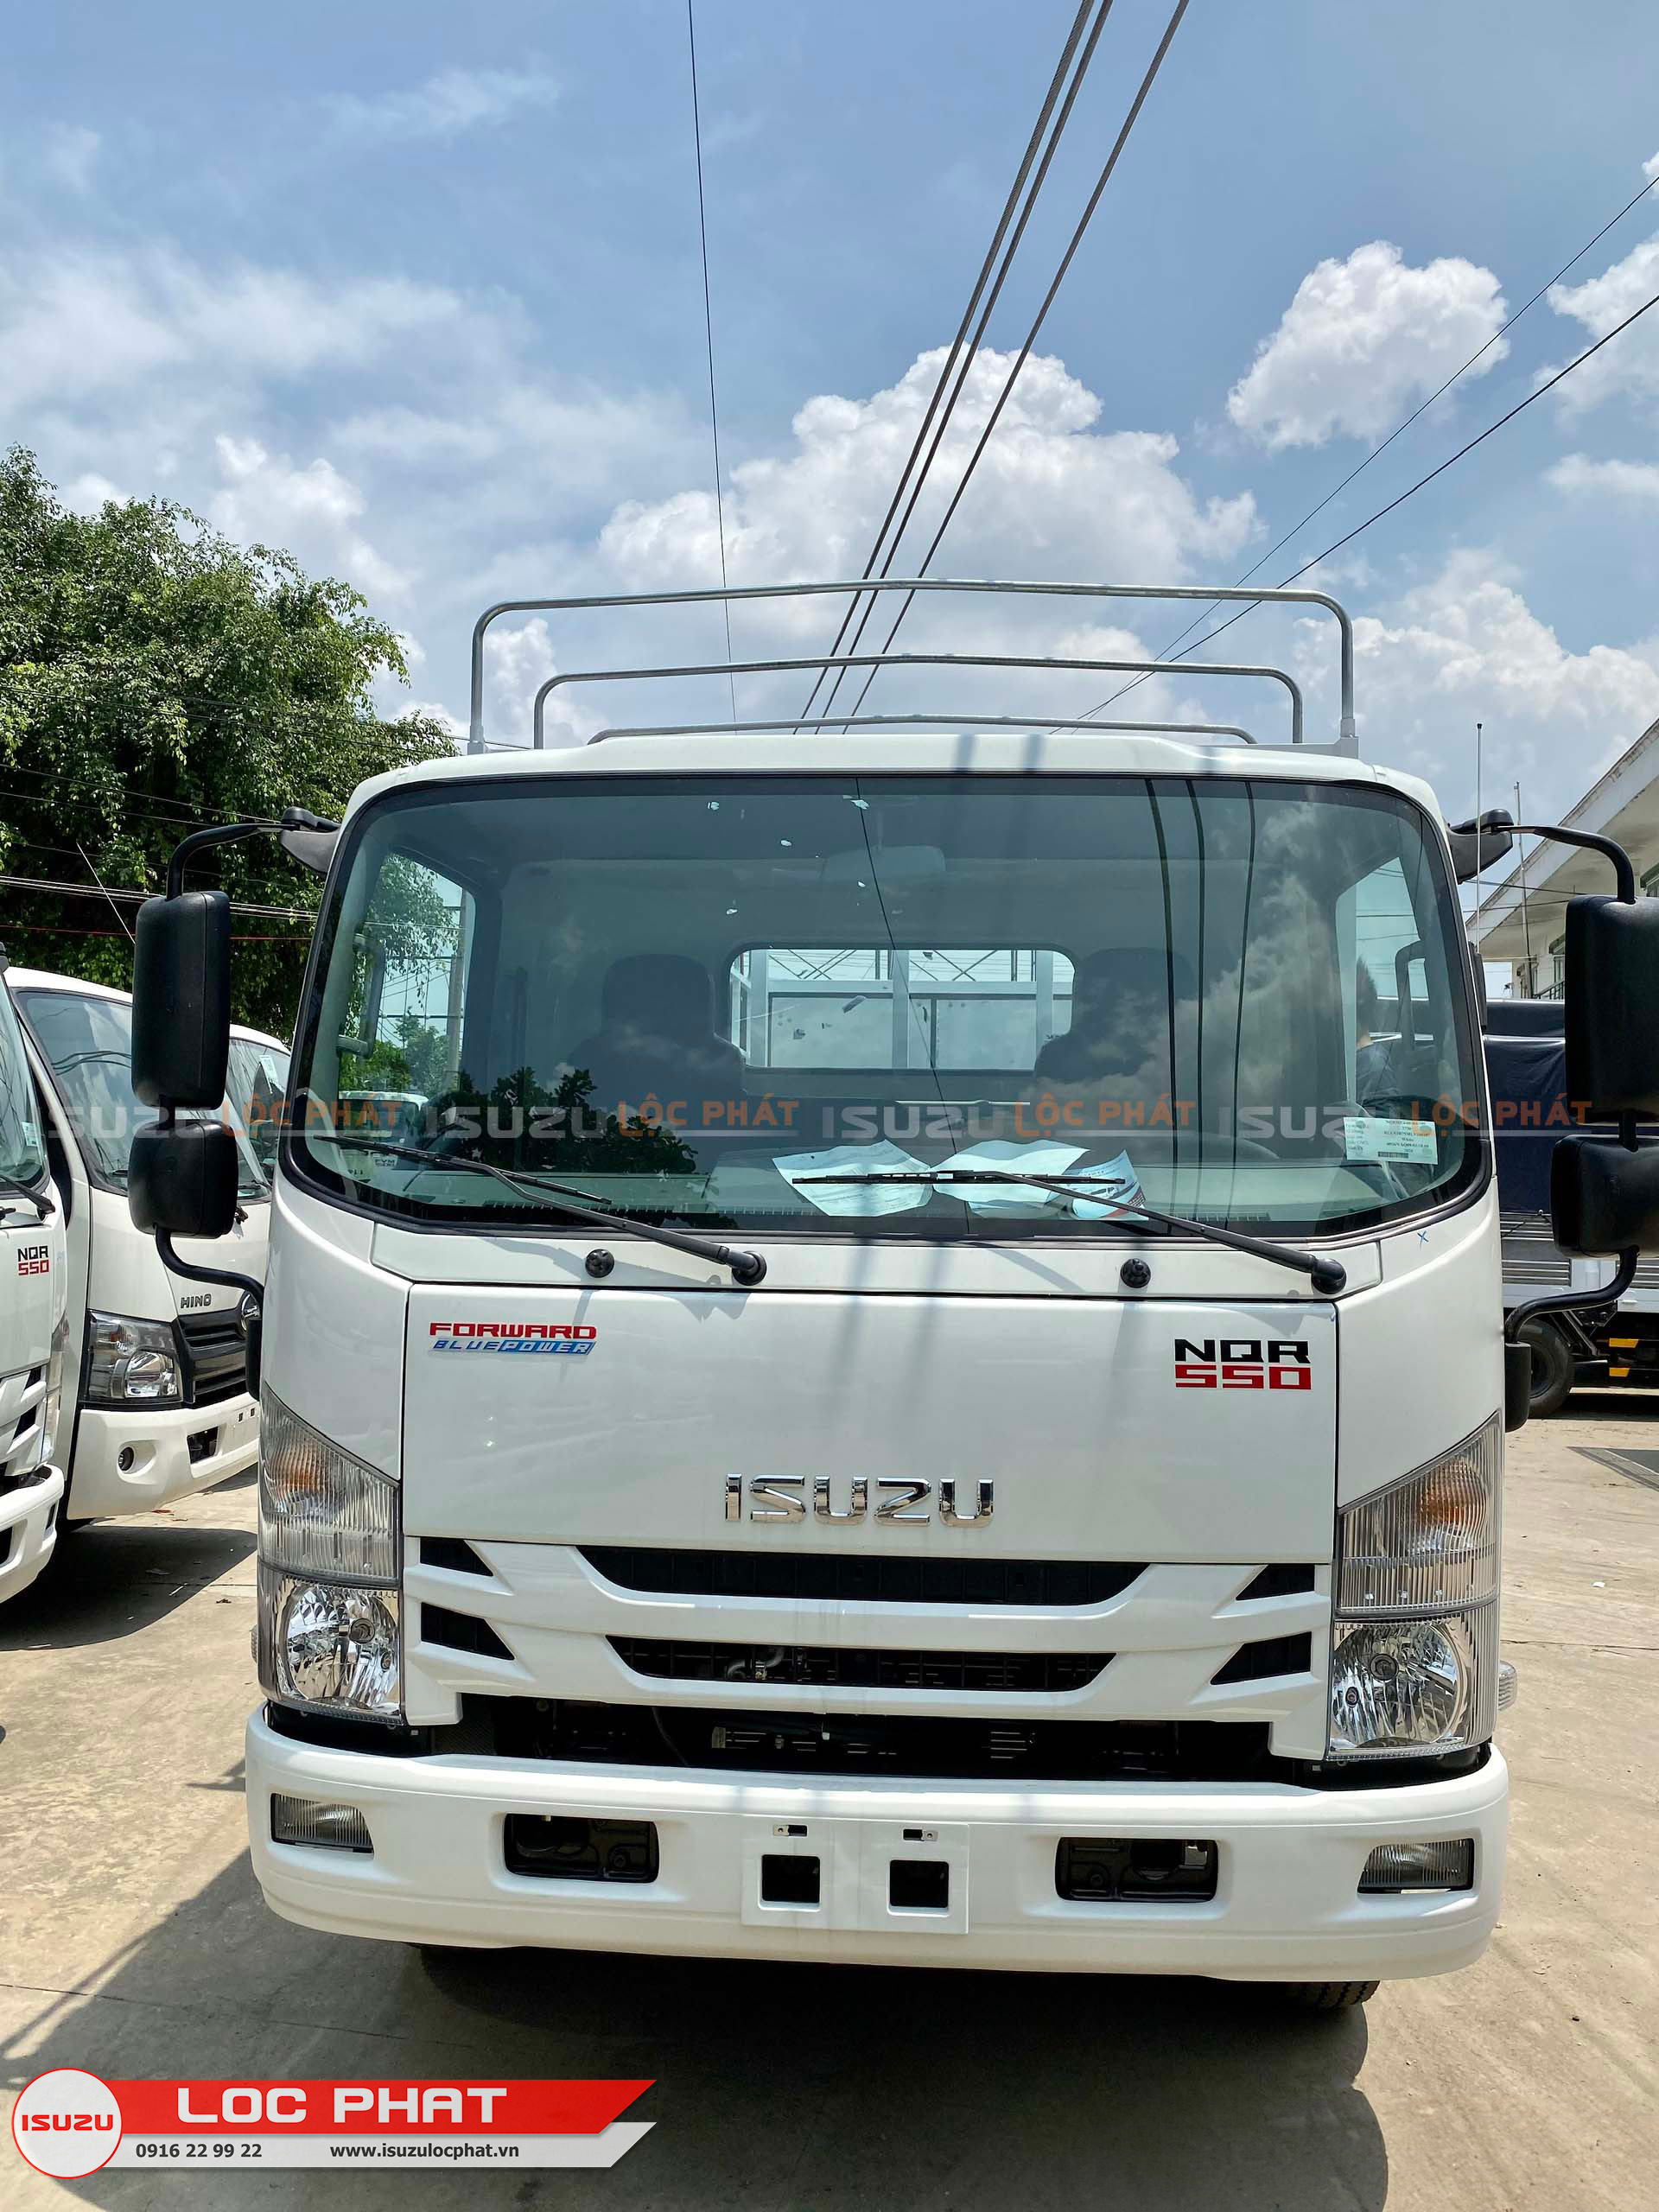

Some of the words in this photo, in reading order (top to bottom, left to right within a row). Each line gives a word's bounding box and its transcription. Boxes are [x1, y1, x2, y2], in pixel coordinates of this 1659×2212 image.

[17, 1245, 49, 1262] NQR
[17, 1259, 50, 1276] 550
[180, 1294, 213, 1309] HINO
[429, 1322, 597, 1339] FORWARD
[1174, 1338, 1311, 1364] NQR
[1174, 1364, 1312, 1390] 550
[724, 1472, 995, 1528] ISUZU
